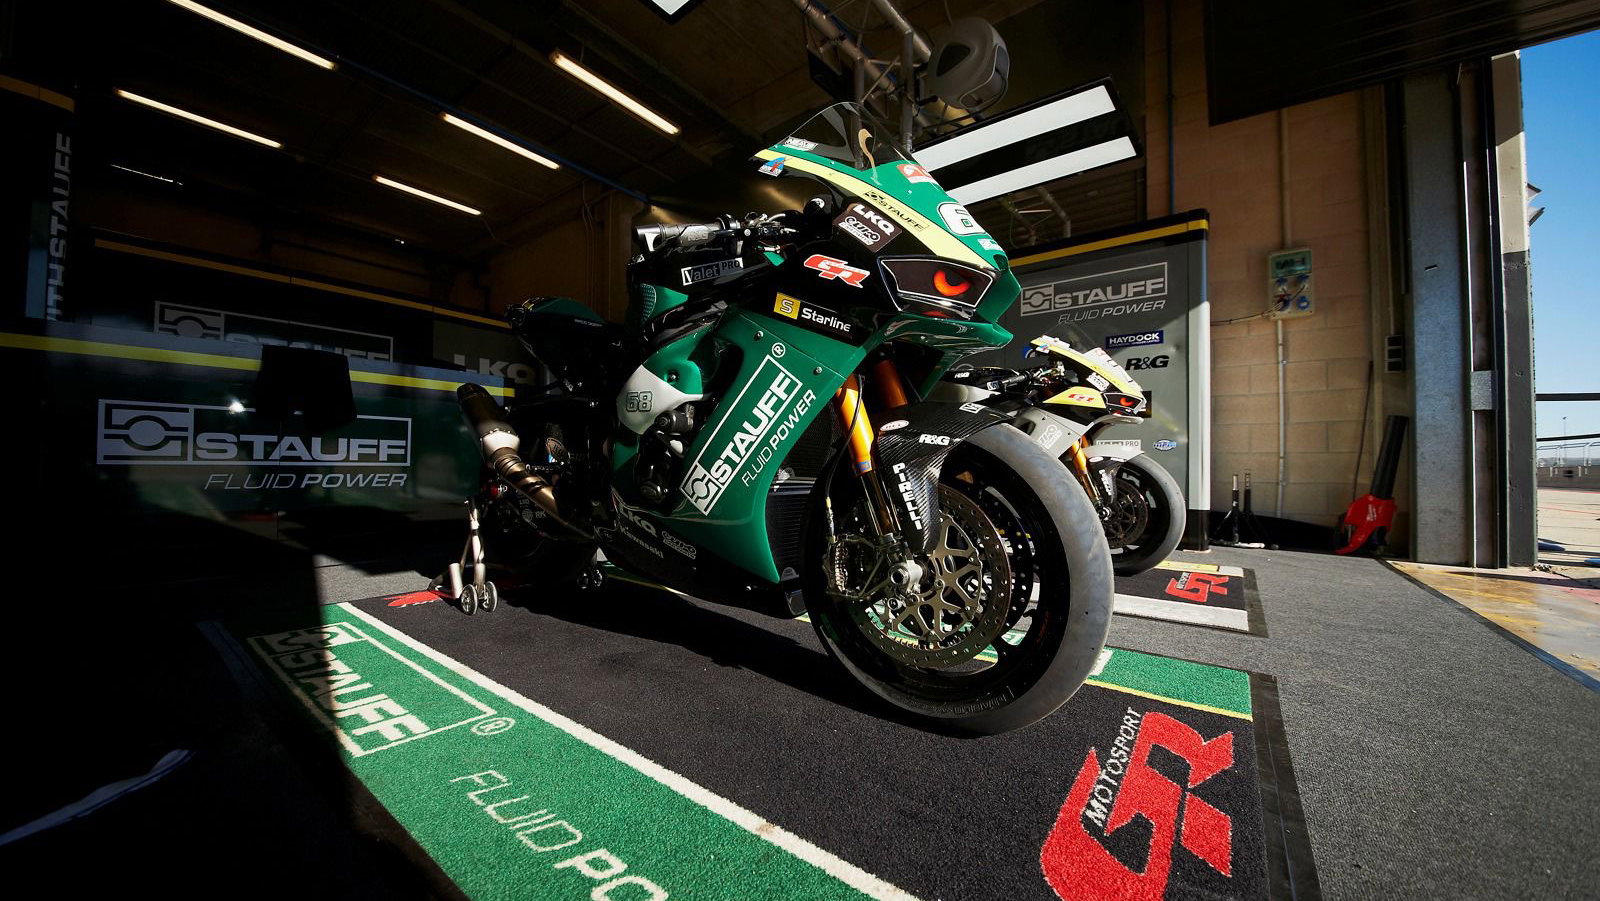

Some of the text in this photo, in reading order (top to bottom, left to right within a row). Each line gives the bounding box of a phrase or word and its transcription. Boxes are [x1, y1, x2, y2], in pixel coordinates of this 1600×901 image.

[49, 132, 72, 259] STAUFF
[852, 204, 895, 236] LKQ
[876, 198, 925, 231] STAUFF
[682, 258, 742, 285] Valet PRO
[1055, 277, 1164, 308] STAUFF
[801, 307, 852, 332] Starline
[1058, 300, 1166, 325] FLUID POWER
[1109, 332, 1160, 345] HAYDOCK
[1125, 355, 1170, 371] R&G
[626, 391, 652, 413] 68
[710, 371, 792, 484] STAUFF
[741, 389, 817, 487] FLUID POWER
[918, 433, 951, 446] R&G
[195, 432, 406, 461] STAUFF
[203, 473, 407, 490] FLUID POWER
[892, 462, 923, 531] PIRELLI
[278, 648, 432, 742] STAUFF
[1085, 706, 1142, 828] MOTOSPORT
[449, 769, 583, 853] FLUID
